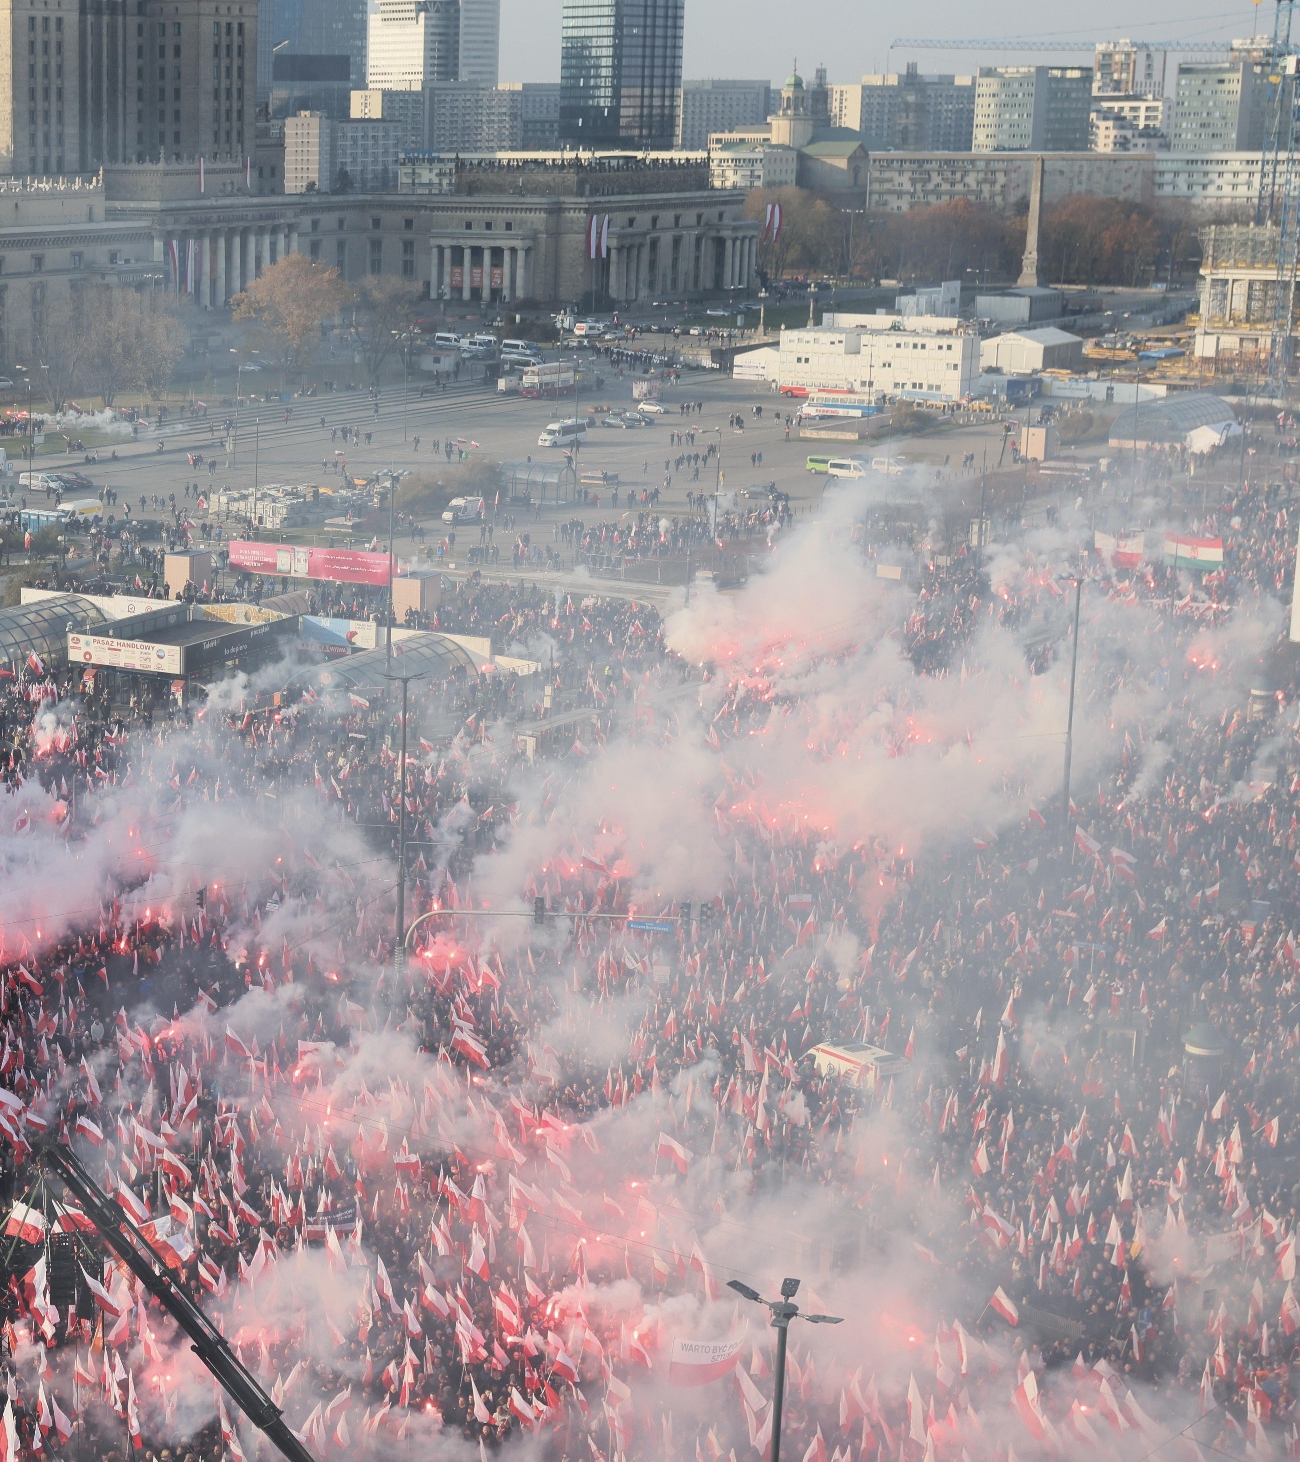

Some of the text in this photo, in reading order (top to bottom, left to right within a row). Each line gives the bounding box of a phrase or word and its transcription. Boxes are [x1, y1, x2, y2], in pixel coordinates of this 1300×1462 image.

[116, 641, 156, 651] HANDLOWY
[681, 1342, 711, 1354] WARTO
[712, 1344, 728, 1354] BYĆ
